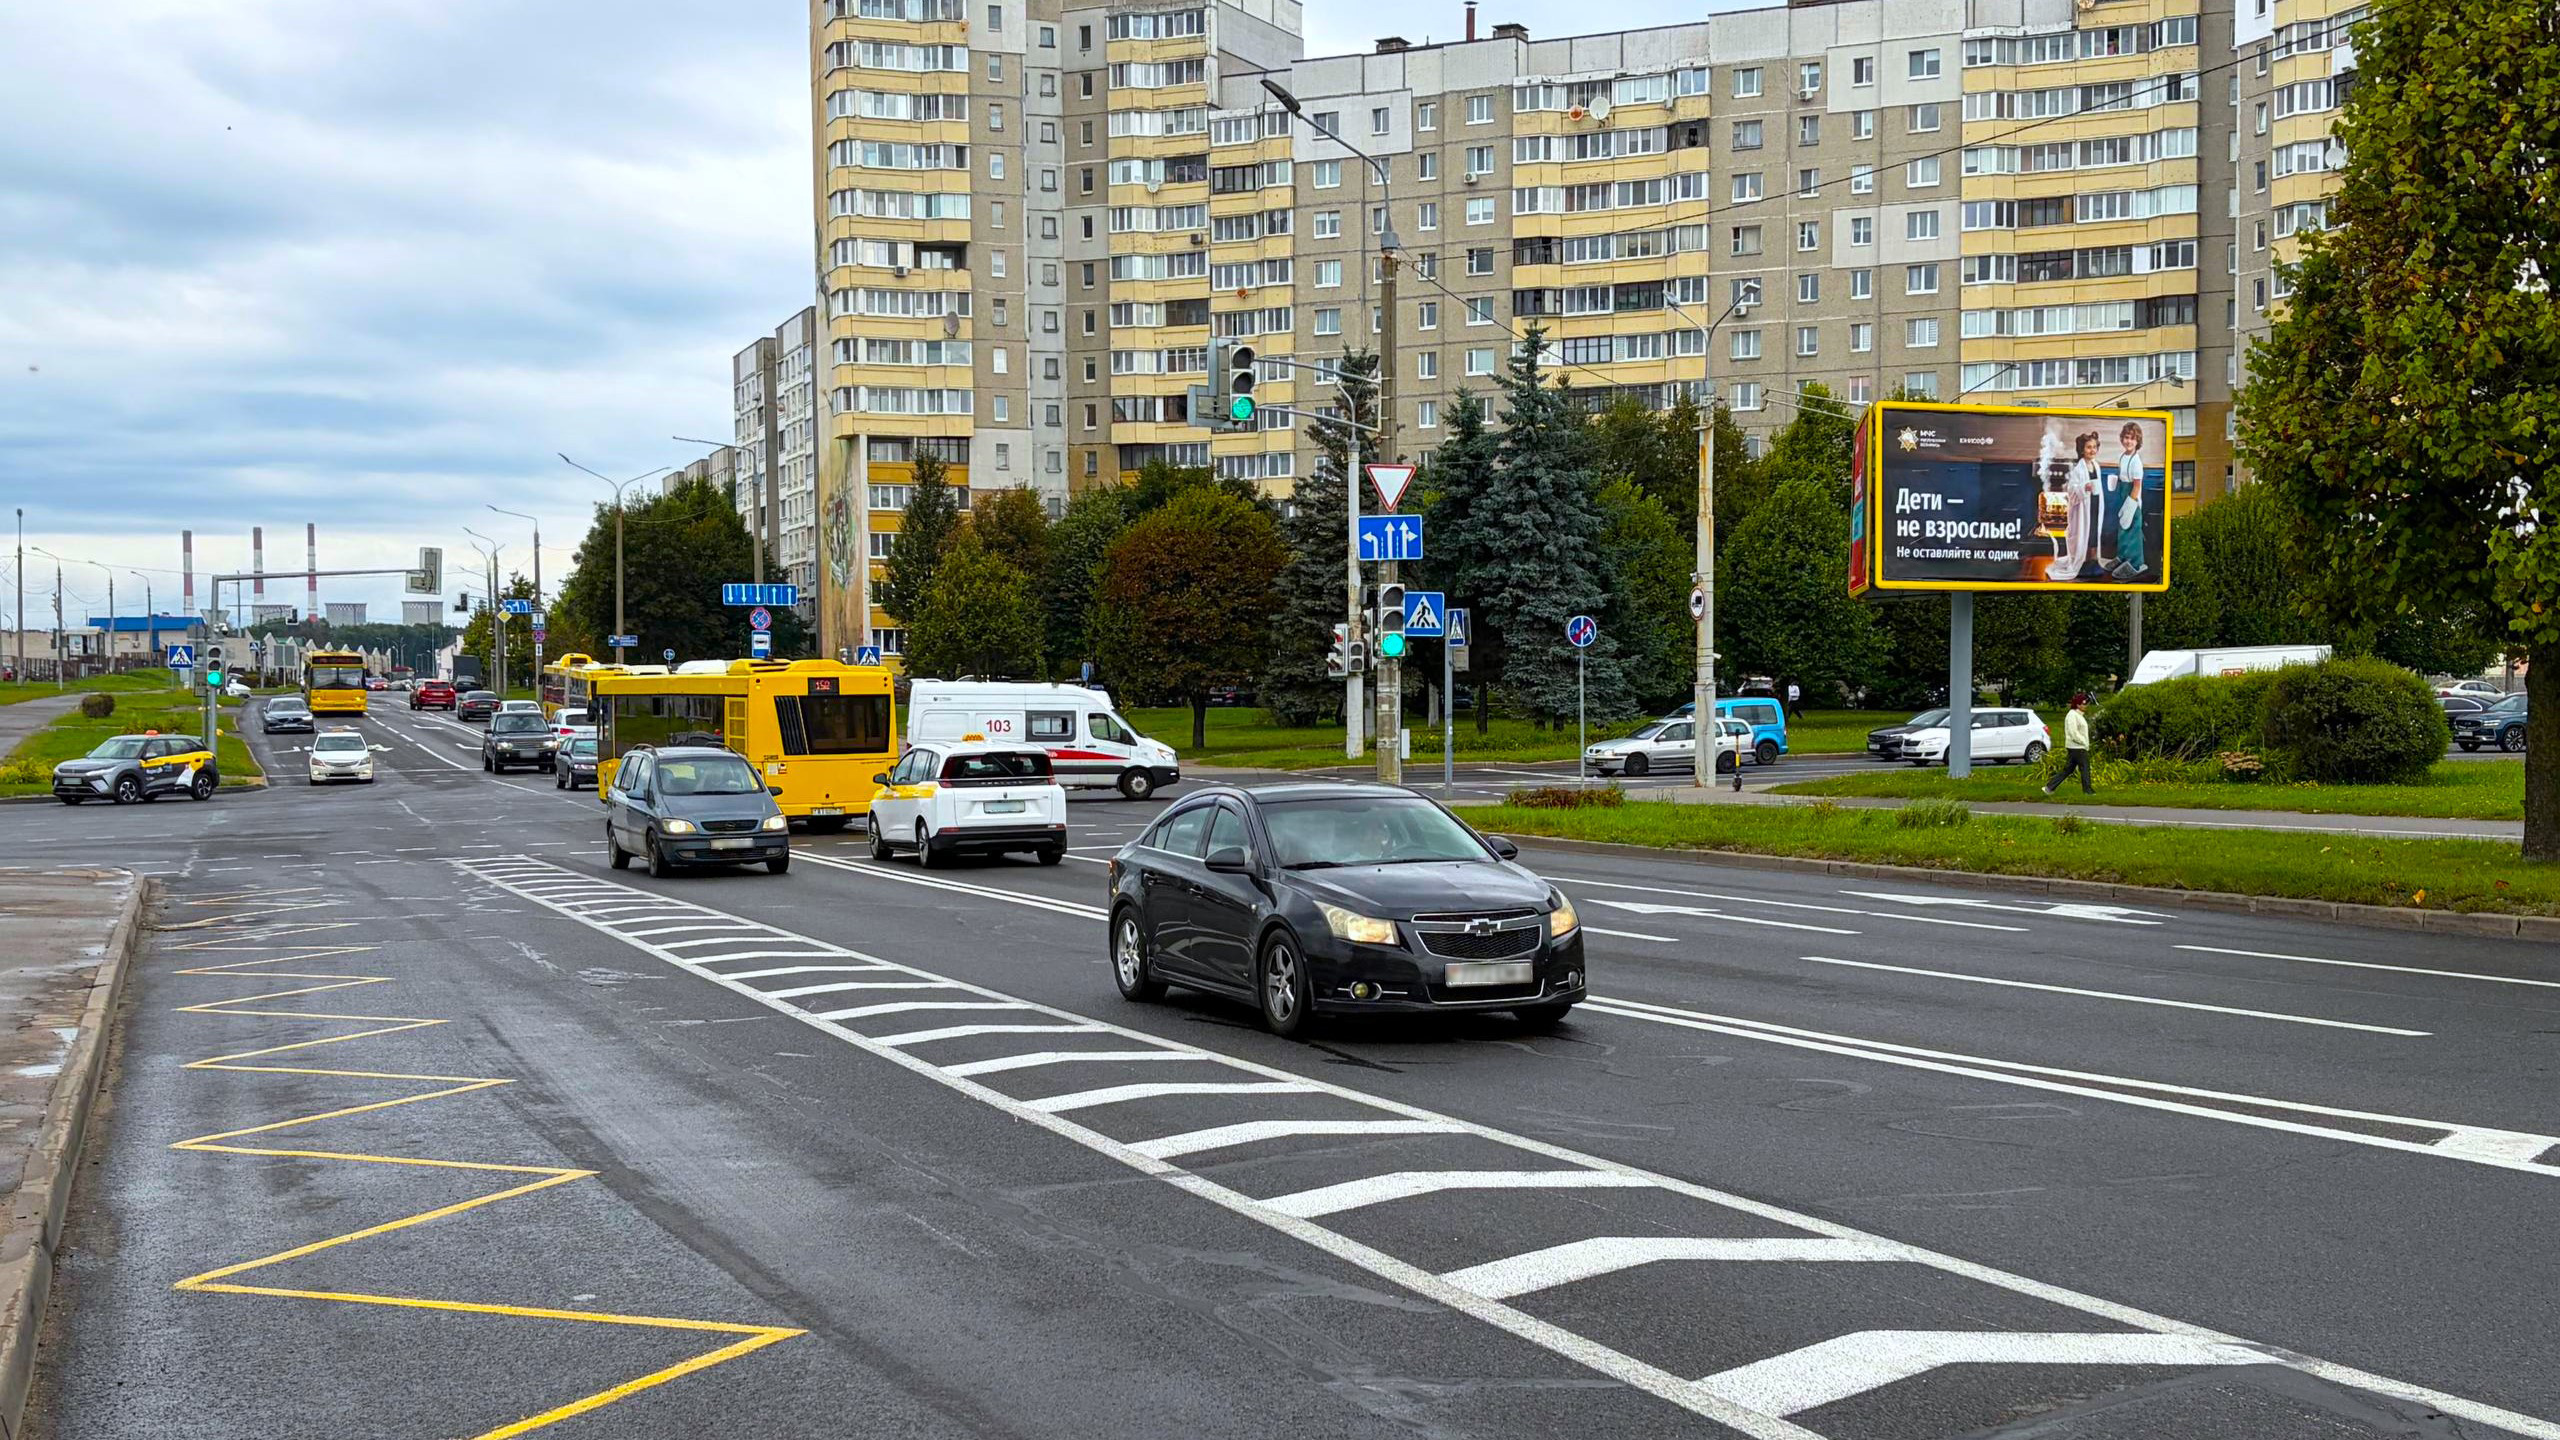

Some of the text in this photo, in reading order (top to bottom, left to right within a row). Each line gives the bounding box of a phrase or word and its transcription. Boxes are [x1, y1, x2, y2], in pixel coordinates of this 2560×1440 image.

[1896, 488, 1942, 514] Дети
[1897, 518, 2021, 544] не взрослые!
[1897, 546, 2019, 562] Не оставляйте их одних
[986, 720, 1011, 732] 103
